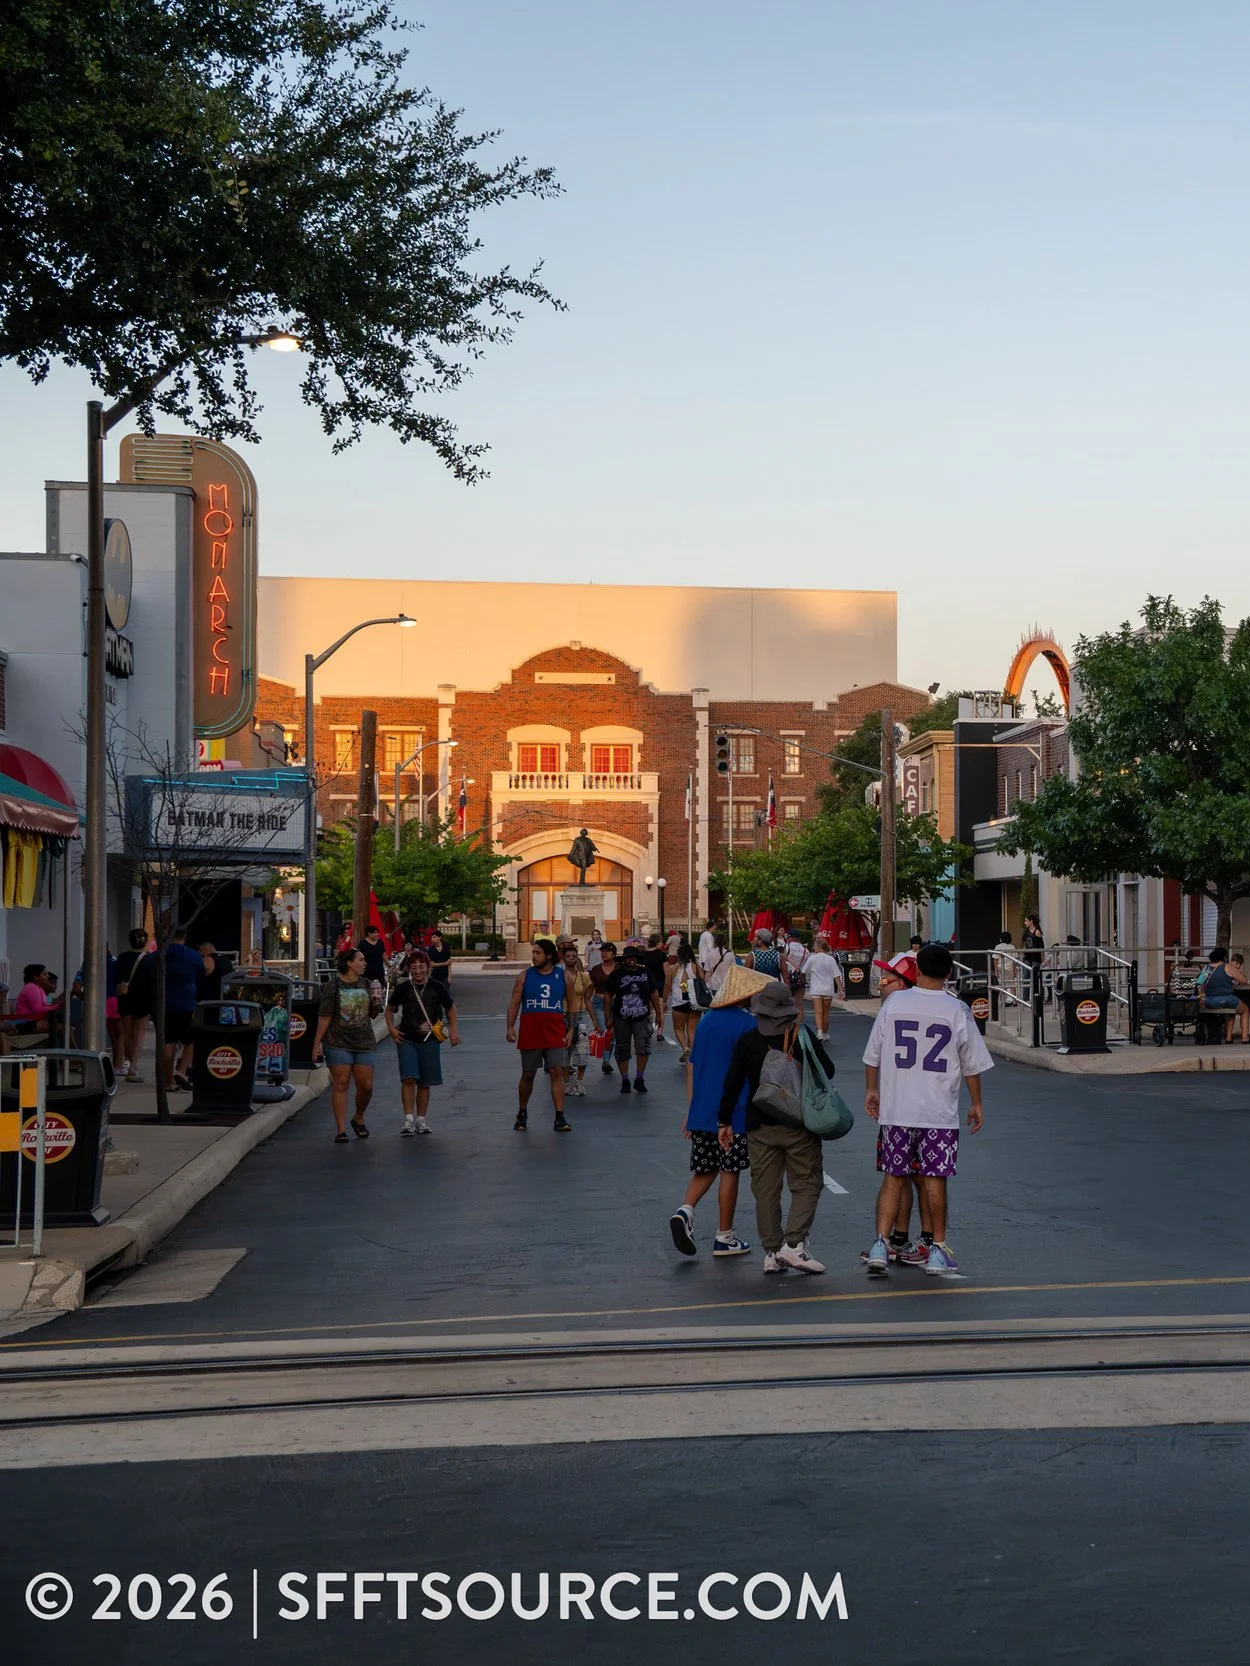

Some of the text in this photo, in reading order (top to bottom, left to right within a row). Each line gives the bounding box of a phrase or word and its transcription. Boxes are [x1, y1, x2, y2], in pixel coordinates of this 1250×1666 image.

[204, 484, 232, 695] MONARCH
[168, 810, 287, 831] BATMAN THE RIDE
[540, 983, 551, 999] 3
[526, 999, 562, 1010] PHILA
[894, 1020, 952, 1073] 52
